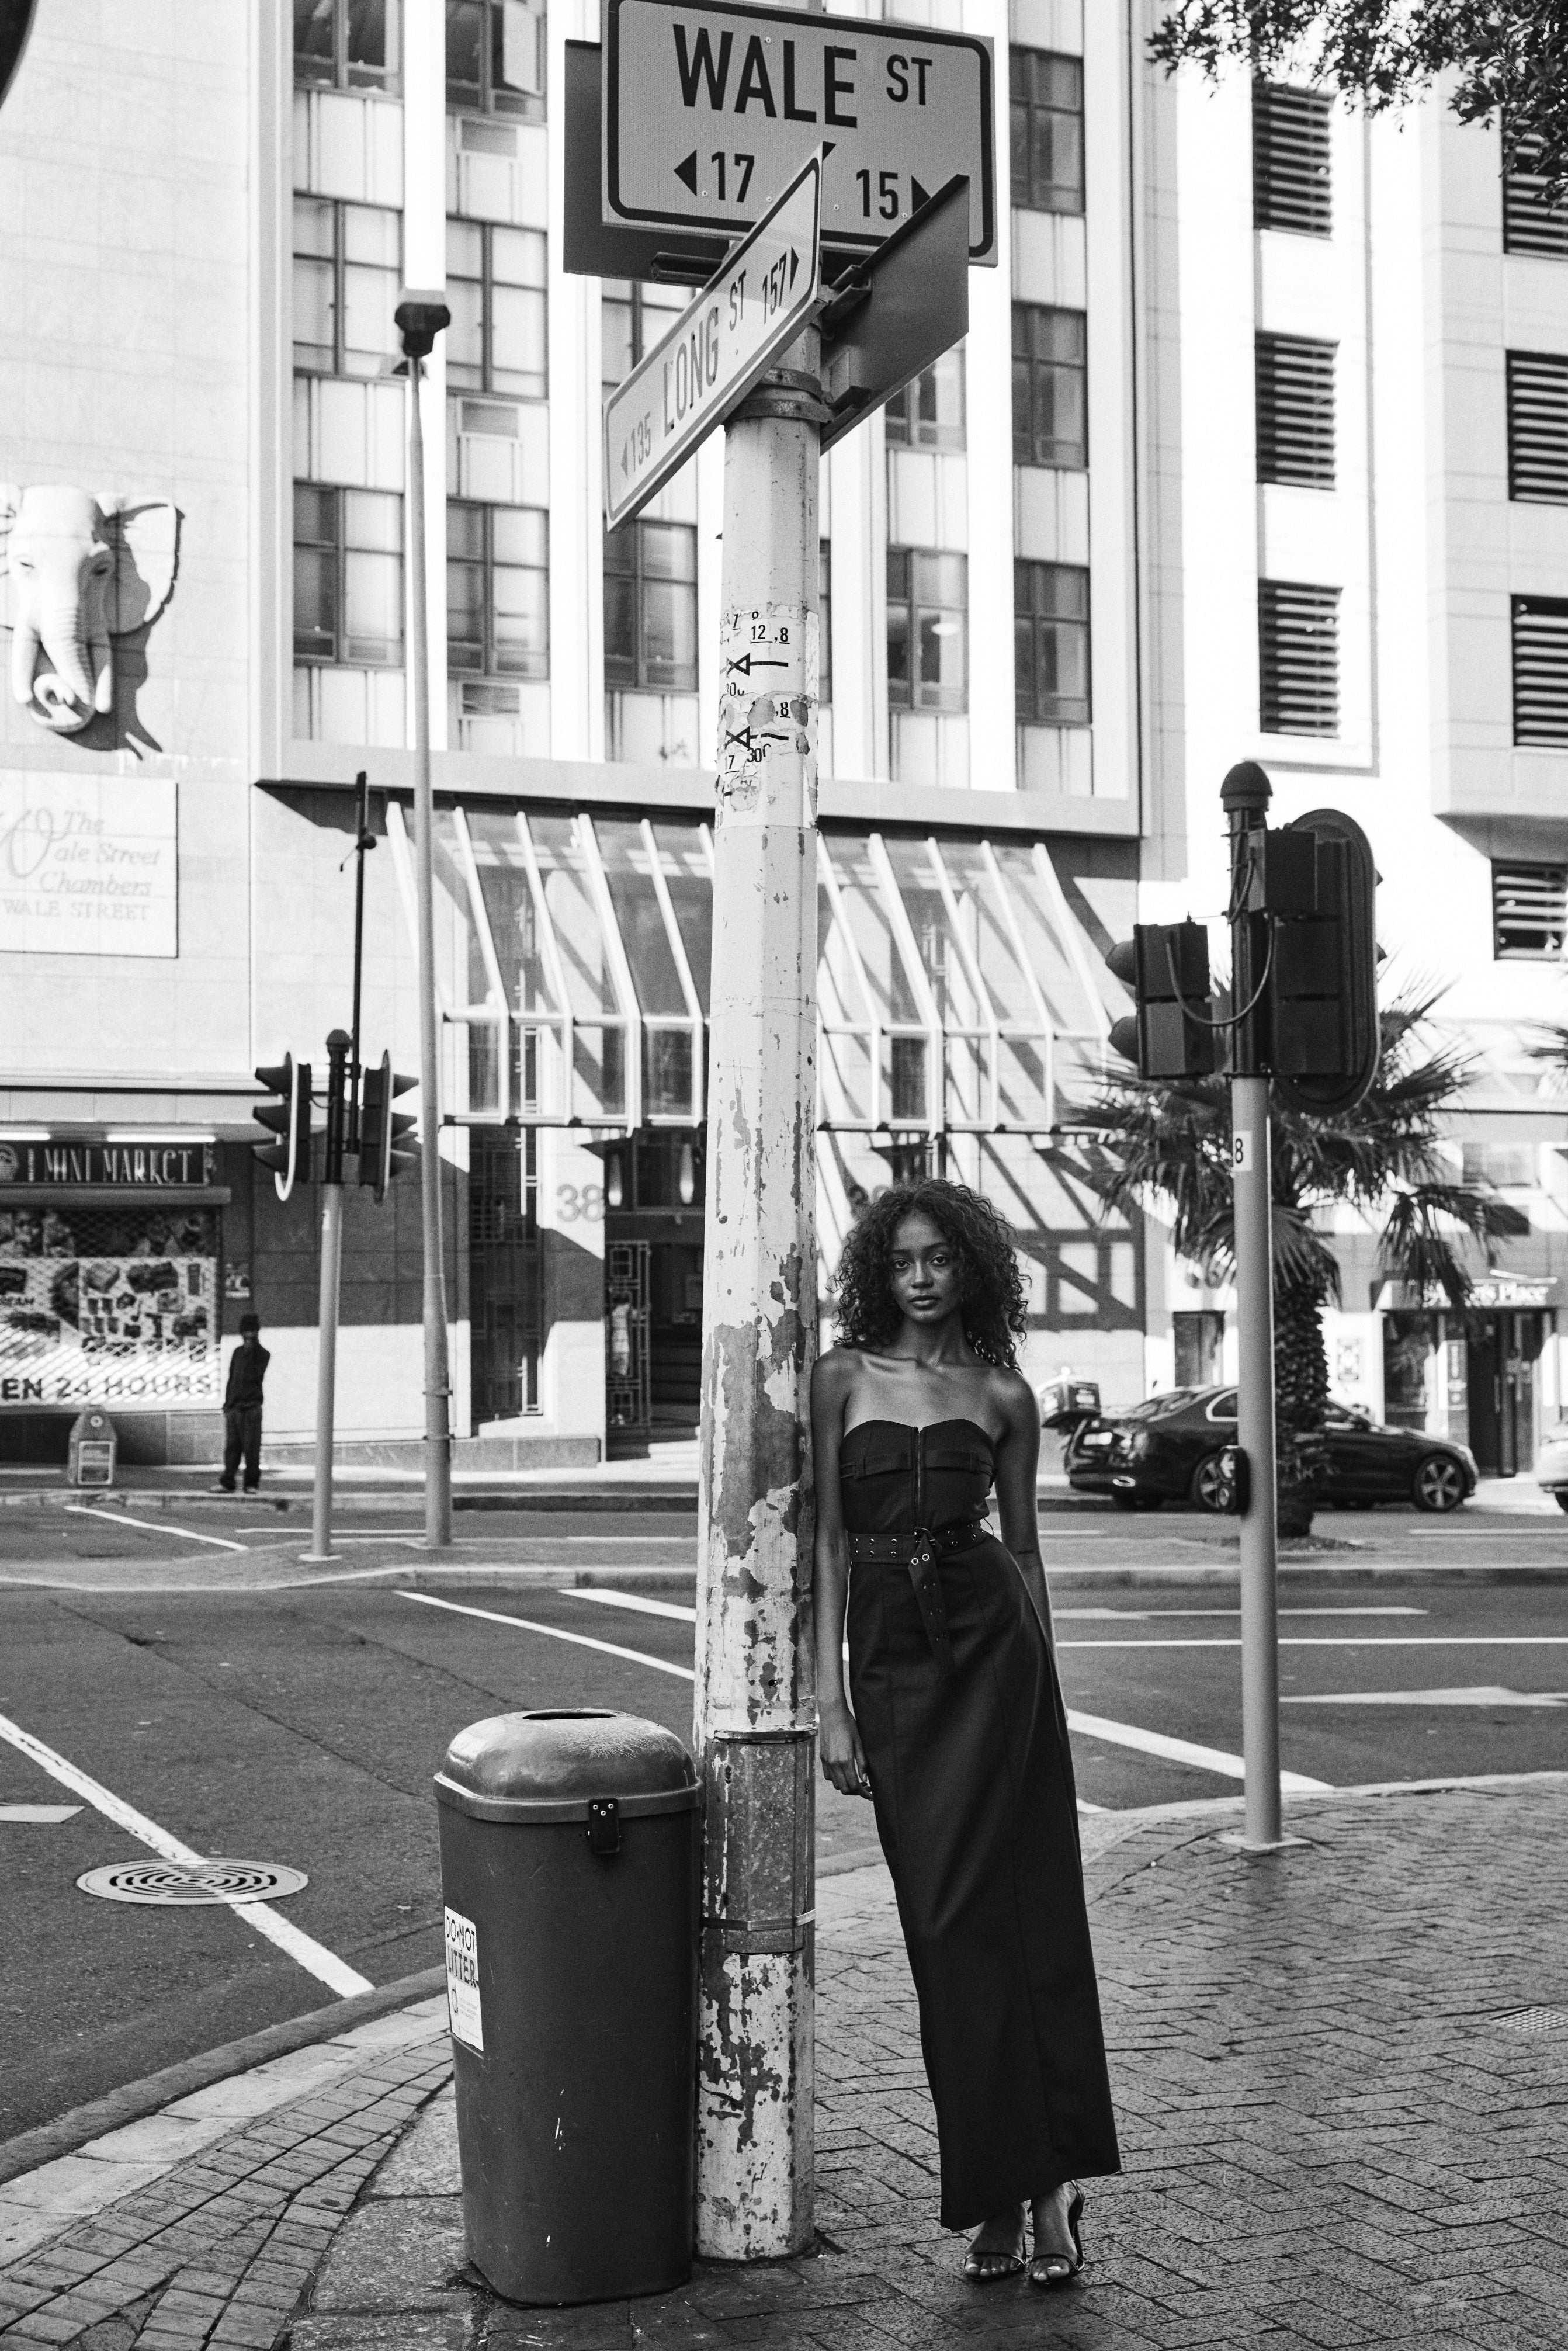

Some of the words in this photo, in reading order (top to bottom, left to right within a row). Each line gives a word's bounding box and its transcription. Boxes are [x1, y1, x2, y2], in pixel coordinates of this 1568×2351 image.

[673, 23, 857, 128] WALE
[886, 54, 932, 105] ST
[710, 151, 755, 203] 17
[856, 168, 899, 220] 15
[762, 252, 788, 325] 157
[663, 306, 719, 438] LONG
[729, 269, 747, 331] ST
[630, 412, 651, 473] 135
[63, 809, 105, 835] The
[97, 842, 161, 865] Street
[39, 871, 152, 897] Chambers
[2, 898, 60, 918] WALE
[71, 901, 150, 922] STREET
[556, 1184, 605, 1223] 38
[447, 1945, 477, 1988] LITTER
